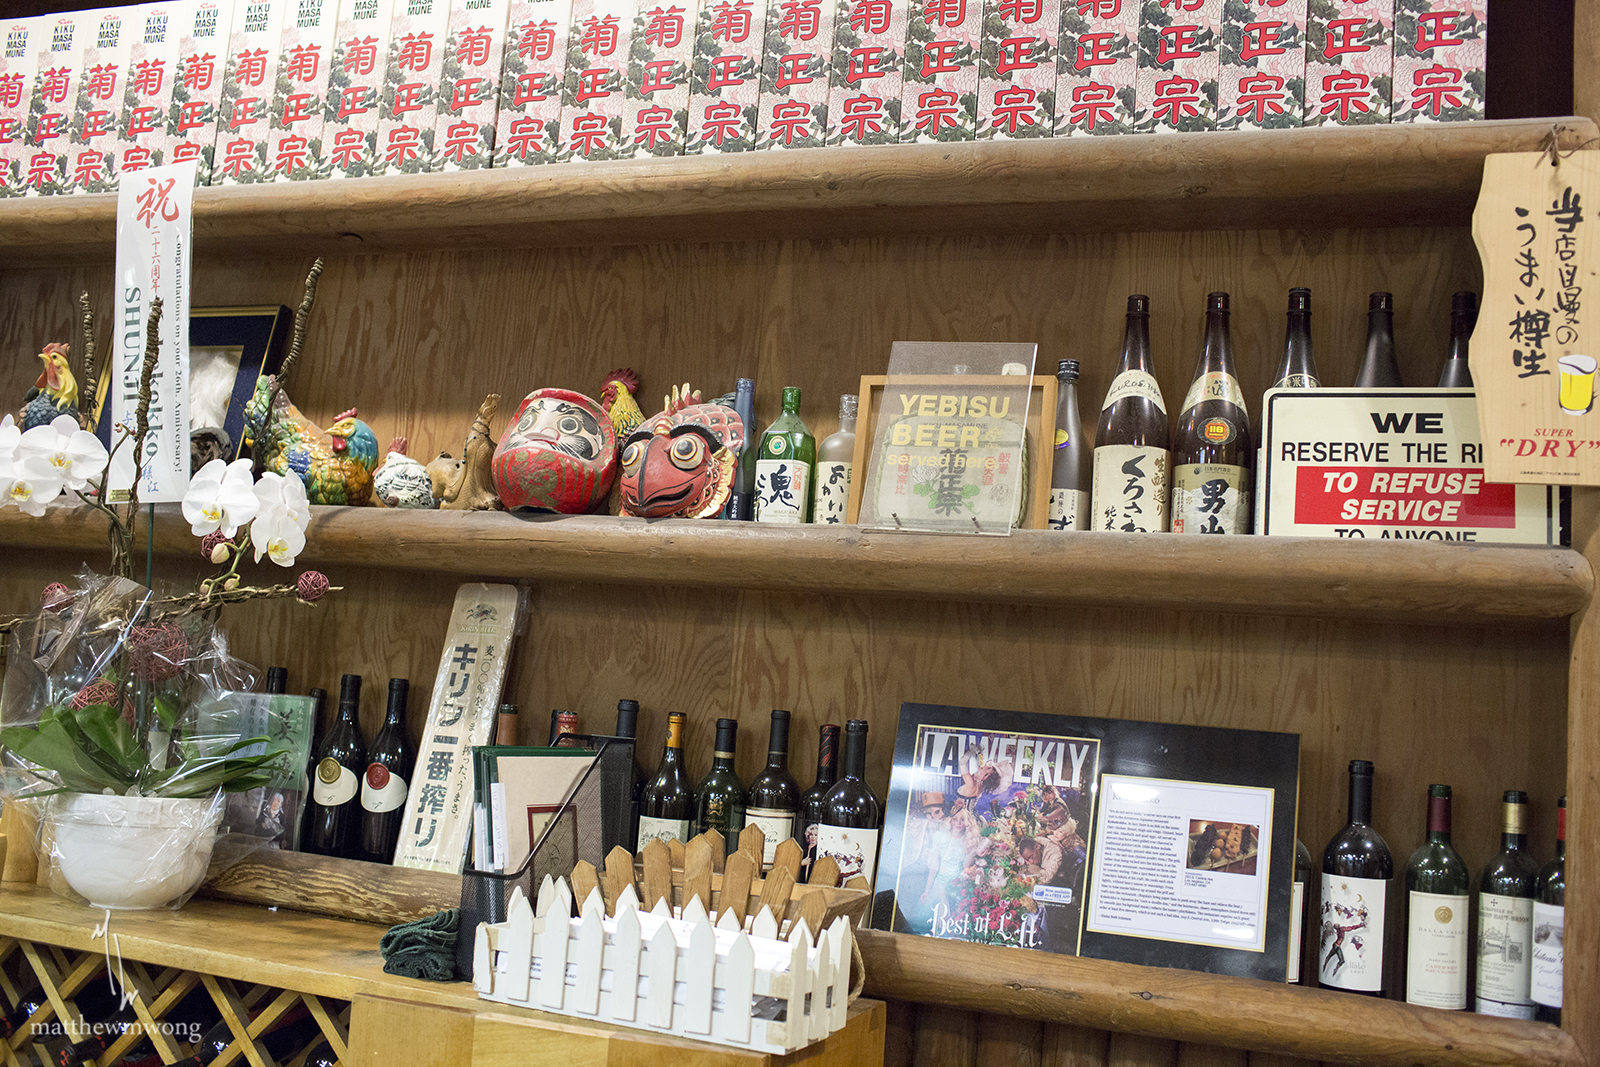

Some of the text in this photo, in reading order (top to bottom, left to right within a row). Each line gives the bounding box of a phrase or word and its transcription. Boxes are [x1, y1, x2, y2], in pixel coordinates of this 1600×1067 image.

[196, 9, 218, 18] KIKU
[247, 4, 270, 13] KIKU
[298, 8, 321, 18] MASA
[353, 10, 377, 21] MUNE
[407, 5, 432, 16] MUNE
[466, 0, 491, 10] MUNE
[100, 21, 121, 30] KIKU
[146, 16, 168, 25] KIKU
[194, 18, 216, 28] MASA
[244, 23, 267, 33] MUNE
[246, 13, 268, 23] MASA
[297, 18, 320, 28] MUNE
[8, 31, 28, 40] KIKU
[52, 34, 72, 43] MASA
[54, 25, 75, 34] KIKU
[98, 30, 119, 39] MASA
[143, 34, 165, 44] MUNE
[145, 25, 166, 34] MASA
[193, 28, 215, 38] MUNE
[5, 49, 25, 58] MUNE
[6, 40, 26, 48] MASA
[51, 43, 71, 52] MUNE
[97, 39, 118, 48] MUNE
[1153, 0, 1204, 125] 正宗
[1237, 0, 1287, 123] 正宗
[634, 5, 686, 149] 菊正宗
[701, 0, 753, 146] 菊正宗
[770, 0, 822, 145] 菊正宗
[443, 25, 494, 163] 菊正宗
[507, 19, 557, 159] 菊正宗
[570, 14, 619, 156] 菊正宗
[275, 43, 321, 175] 菊正宗
[331, 35, 379, 169] 菊正宗
[385, 31, 434, 167] 菊正宗
[121, 58, 166, 173] 菊正宗
[222, 47, 269, 178] 菊正宗
[27, 66, 71, 189] 菊正宗
[73, 63, 118, 187] 菊正宗
[136, 177, 180, 229] 祝
[123, 287, 141, 402] SHUNJI
[173, 340, 182, 367] your
[899, 394, 1010, 418] YEBISU
[1370, 412, 1444, 434] WE
[1533, 428, 1574, 437] SUPER
[172, 402, 182, 473] Anniversary!
[891, 424, 981, 448] BEER
[887, 453, 951, 468] served
[1281, 442, 1389, 462] RESERVE
[1402, 443, 1448, 463] THE
[1322, 472, 1484, 495] TO REFUSE
[1341, 498, 1462, 522] SERVICE
[927, 903, 970, 937] Best
